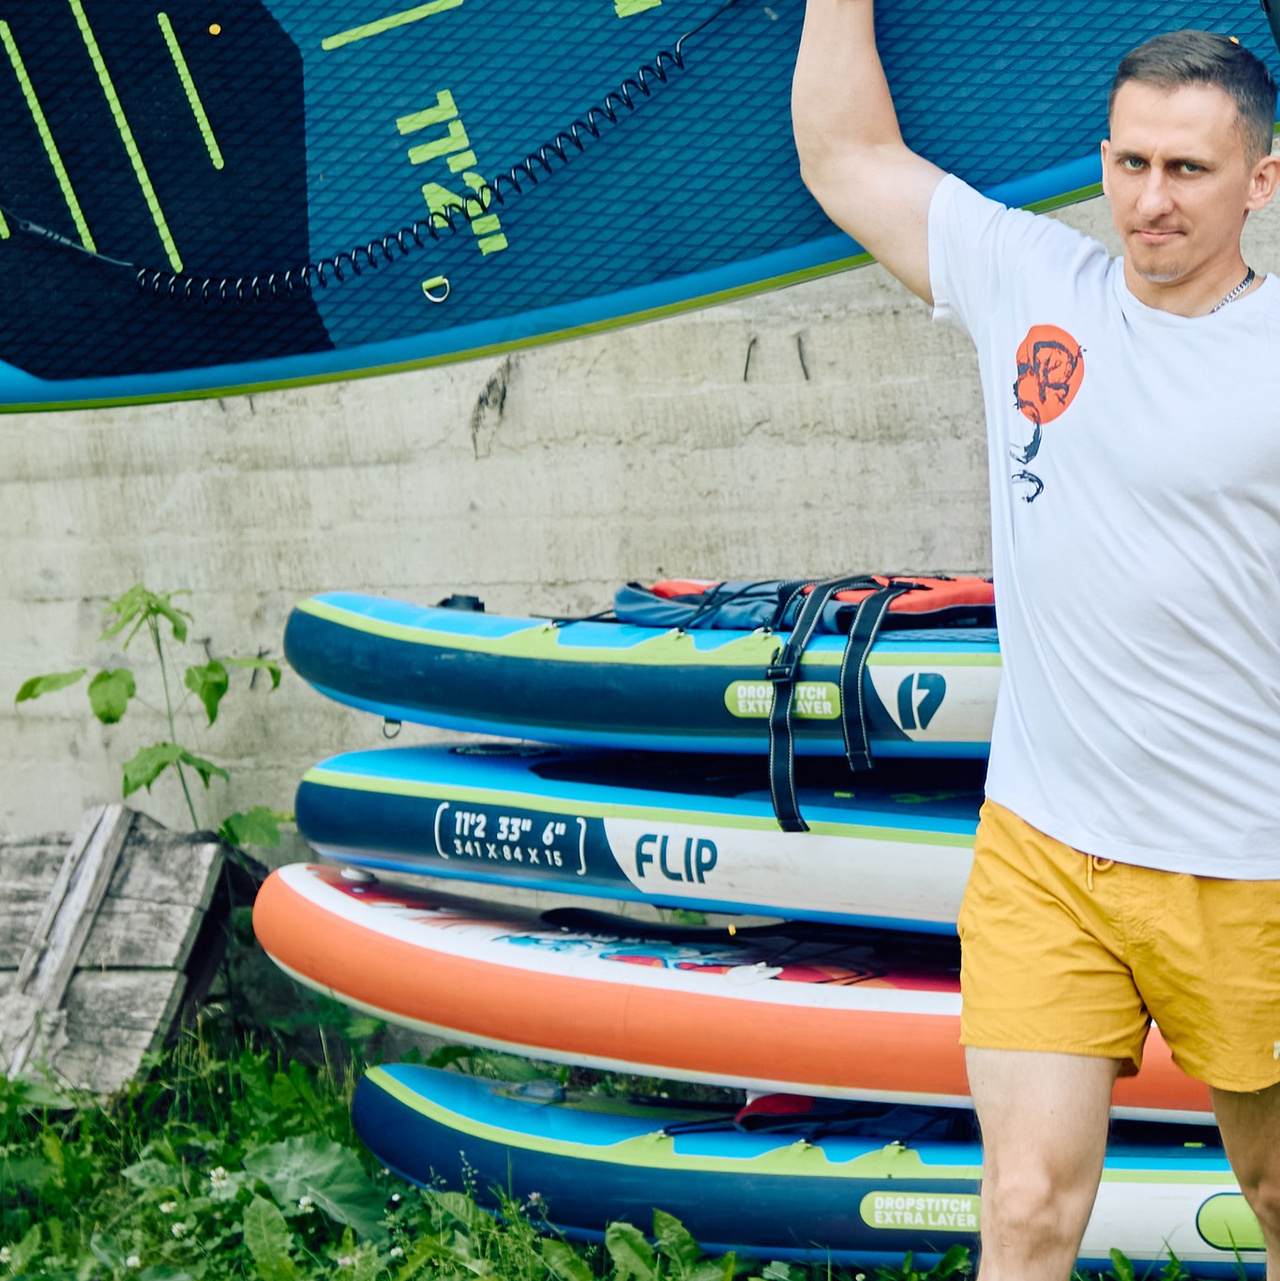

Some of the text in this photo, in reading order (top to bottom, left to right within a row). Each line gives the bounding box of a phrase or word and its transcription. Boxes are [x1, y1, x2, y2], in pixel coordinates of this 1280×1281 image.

[738, 700, 832, 715] EXTR AYER
[455, 811, 566, 846] 11'2 33" 6"
[635, 833, 718, 884] FLIP
[873, 1196, 971, 1212] DROPSTITCH
[874, 1211, 976, 1228] EXTRA LAYER
